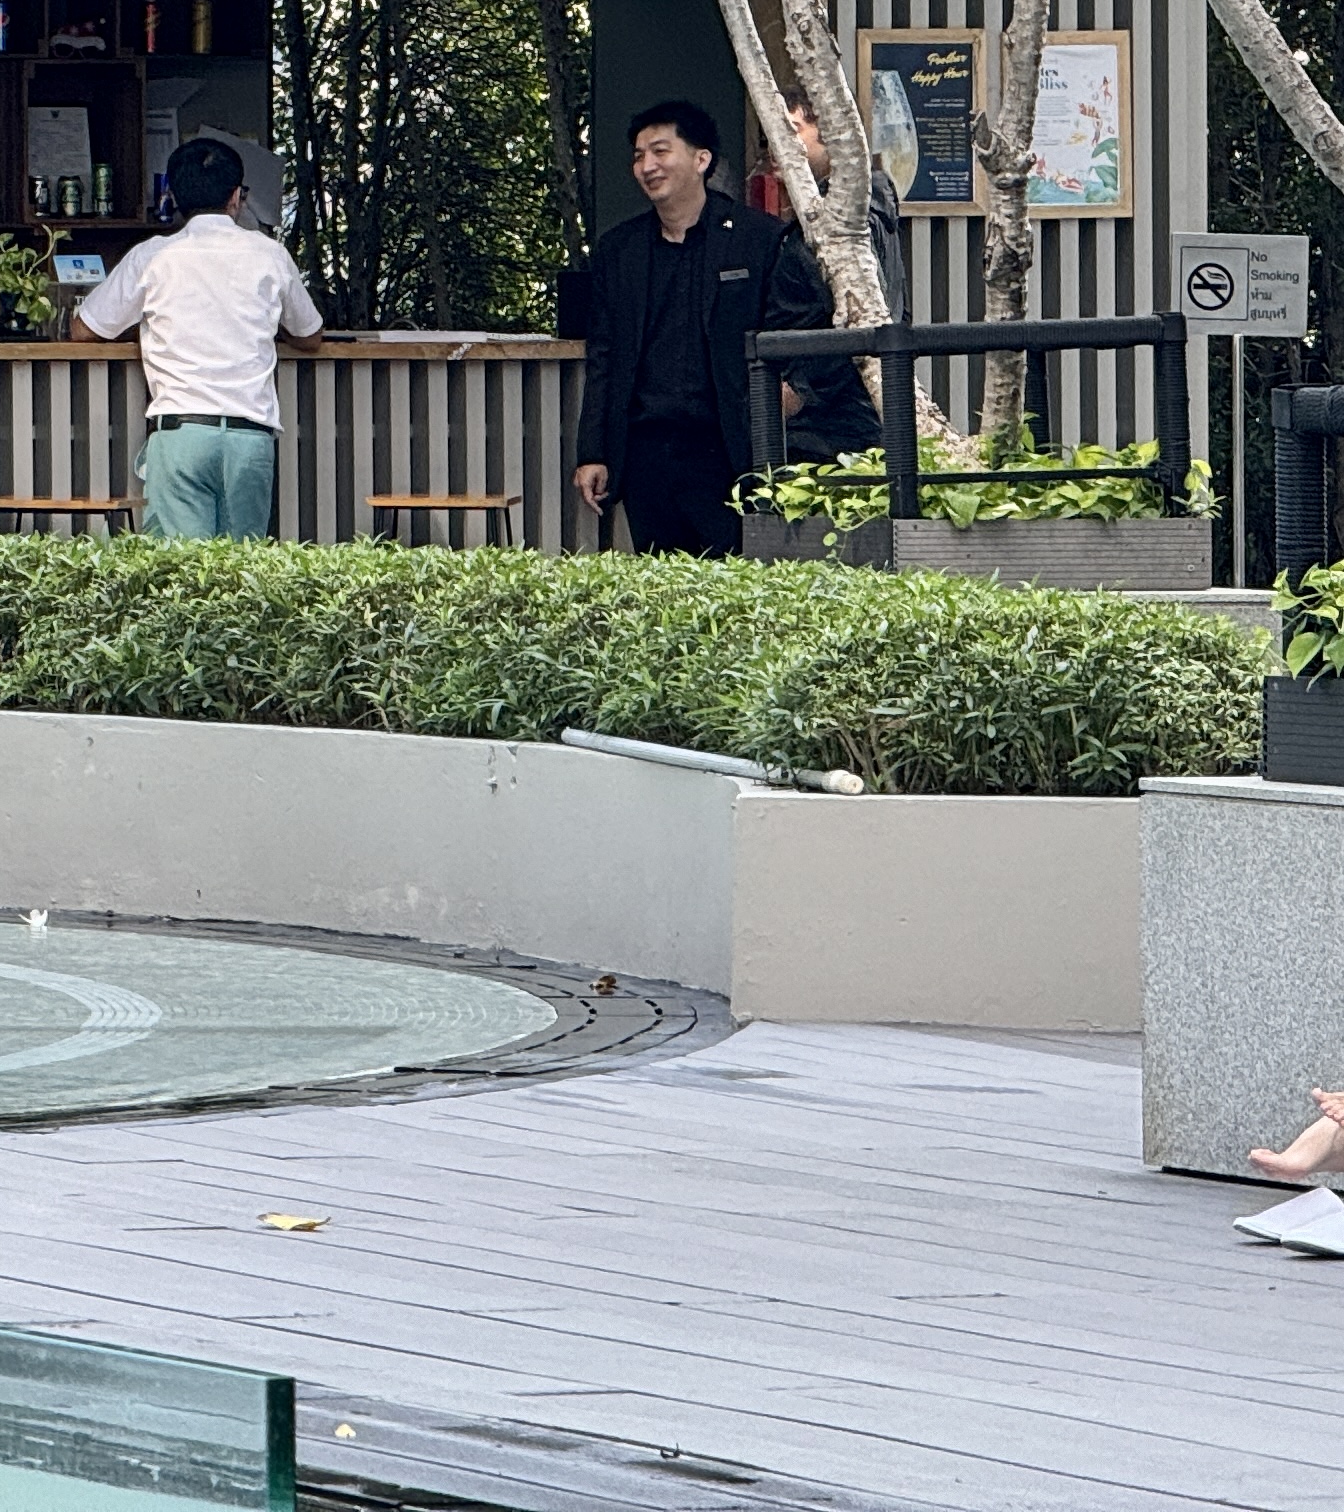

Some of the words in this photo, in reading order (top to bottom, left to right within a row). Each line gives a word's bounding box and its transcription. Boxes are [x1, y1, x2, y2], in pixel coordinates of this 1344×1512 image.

[910, 69, 942, 87] Happy
[1251, 251, 1268, 262] No
[1250, 269, 1300, 284] Smoking
[1250, 287, 1272, 300] ห้าม
[1250, 304, 1287, 321] สูบบุหรี่
